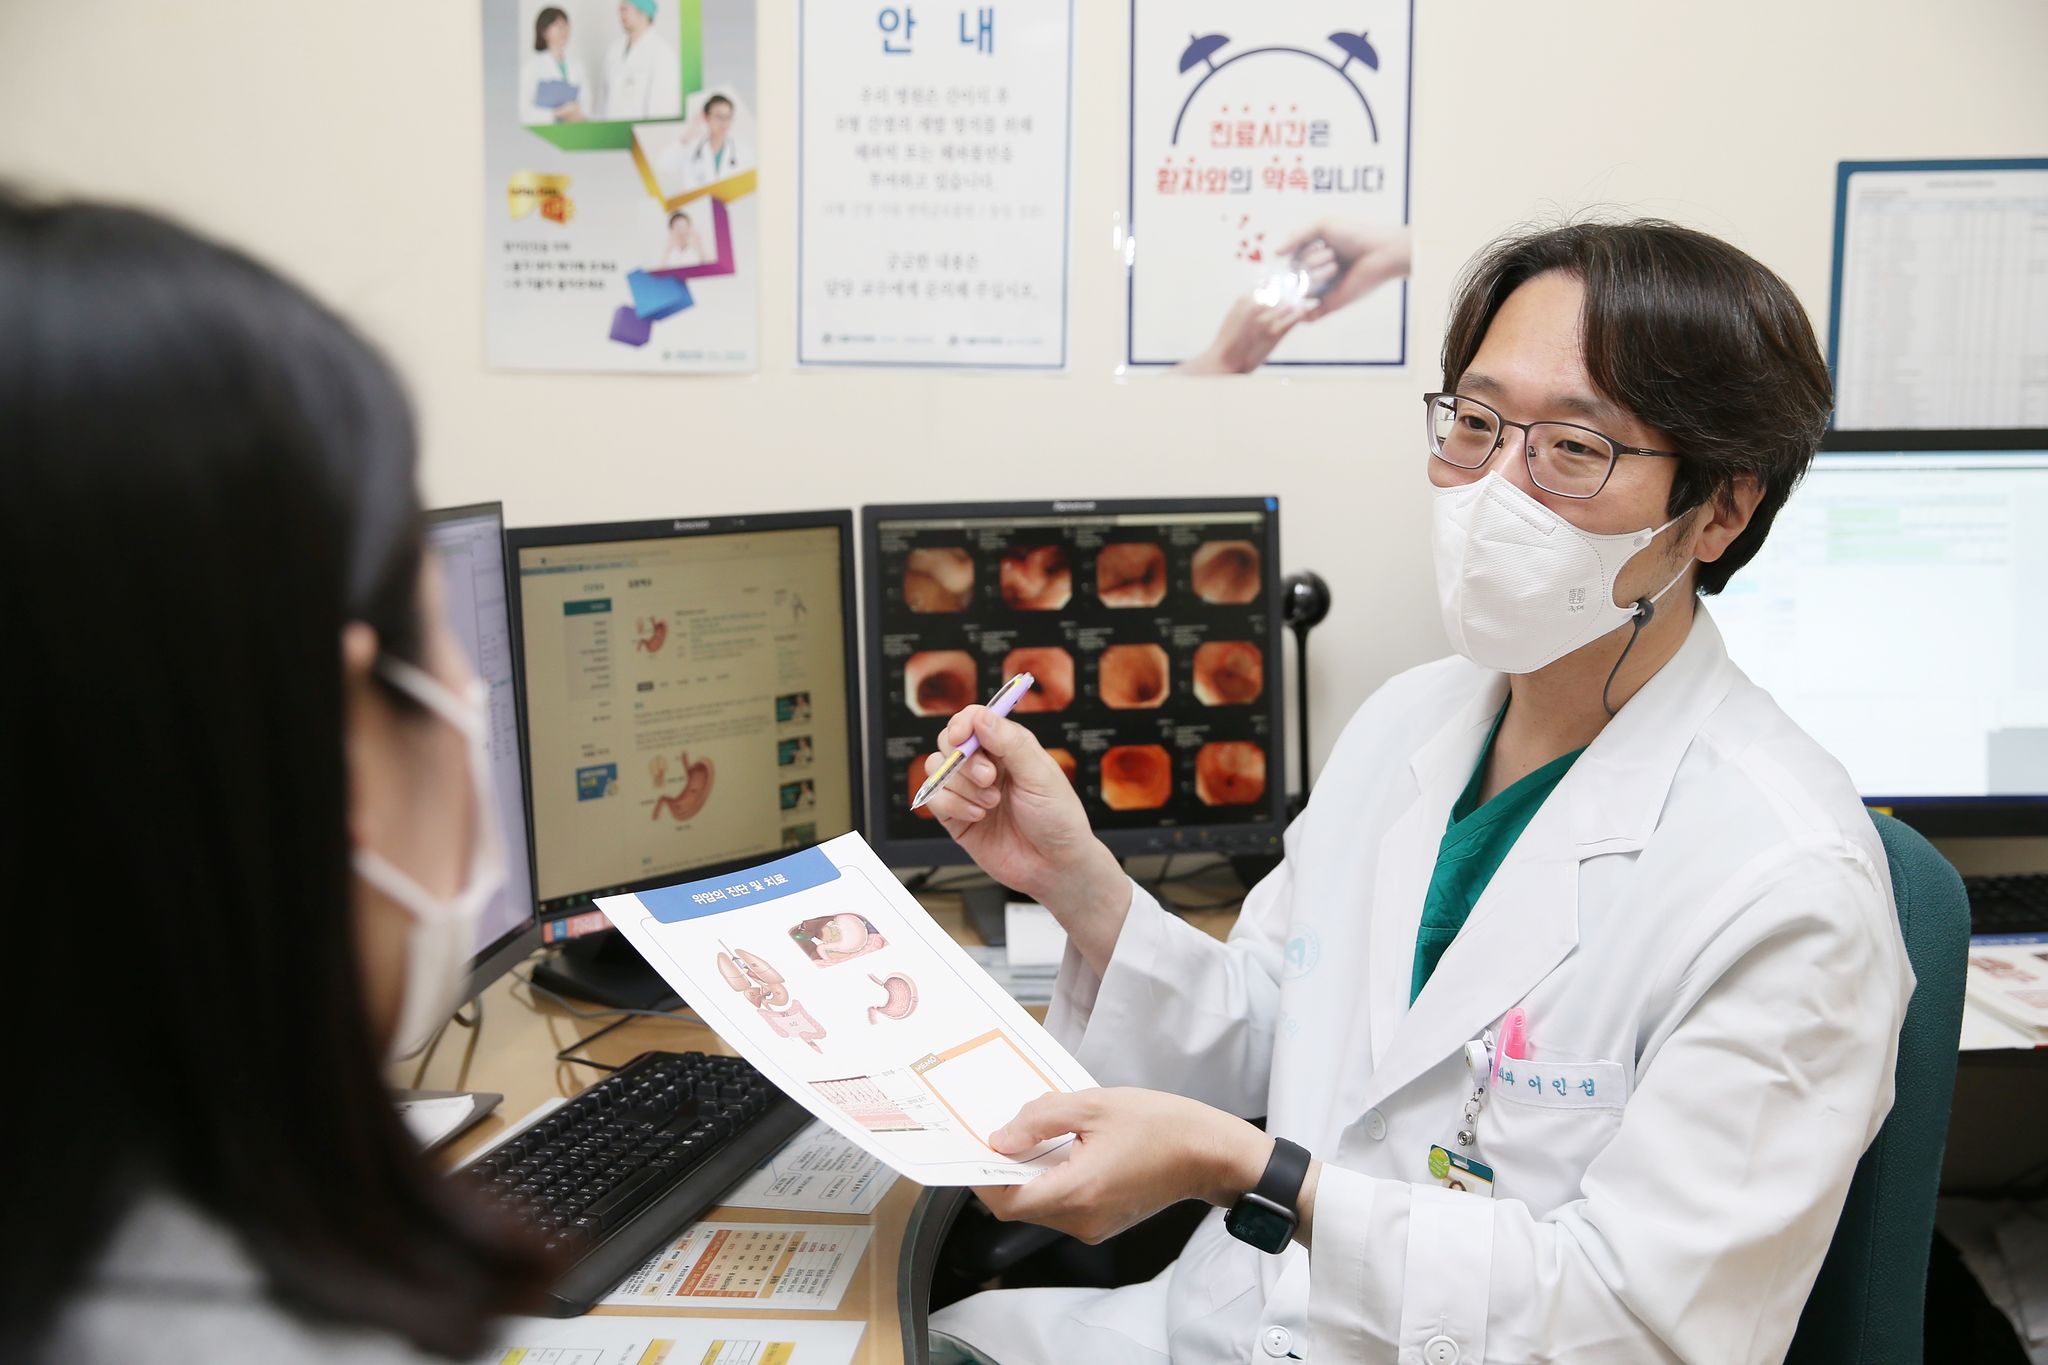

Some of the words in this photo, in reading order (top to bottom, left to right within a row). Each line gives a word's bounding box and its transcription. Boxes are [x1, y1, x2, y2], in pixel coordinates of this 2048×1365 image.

[878, 7, 917, 55] 안
[958, 6, 995, 55] 내
[1210, 120, 1330, 149] 진료시간은
[1156, 165, 1253, 195] 환자와의
[1263, 164, 1385, 194] 약속입니다
[691, 889, 728, 905] 위암의
[725, 883, 751, 897] 진단
[749, 880, 766, 892] 및
[763, 873, 789, 887] 치료
[914, 1055, 937, 1072] MEMO
